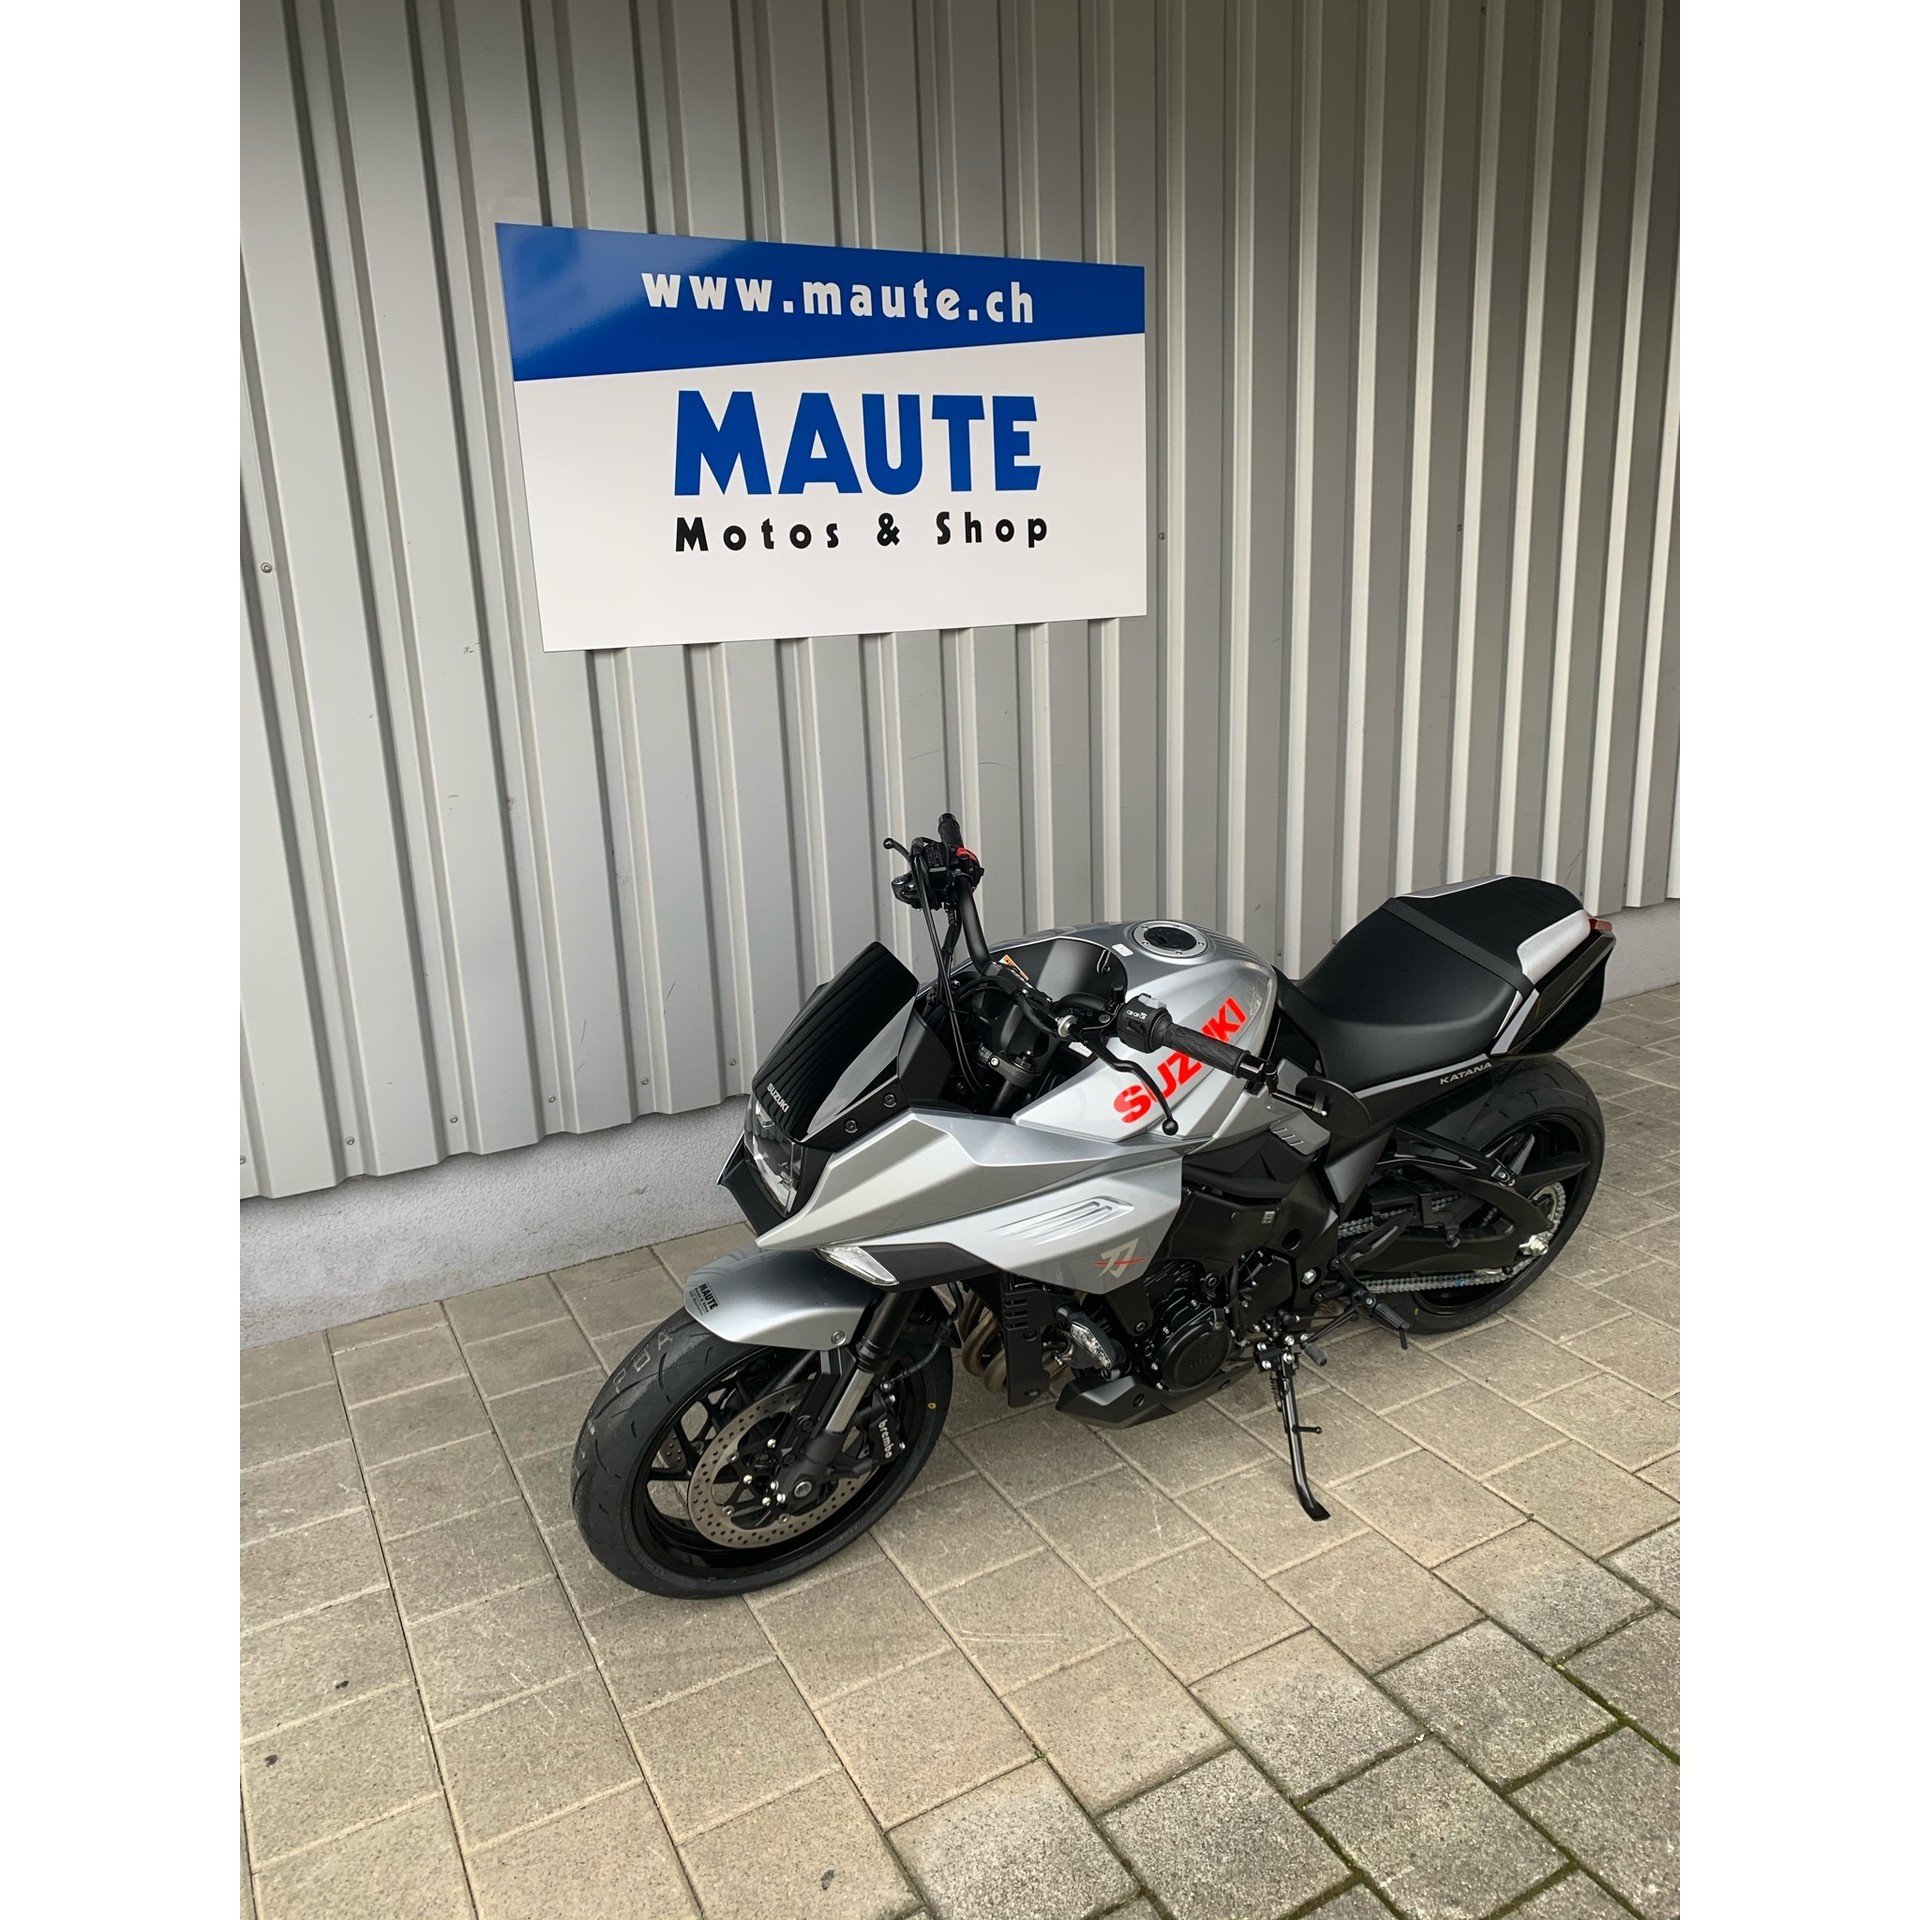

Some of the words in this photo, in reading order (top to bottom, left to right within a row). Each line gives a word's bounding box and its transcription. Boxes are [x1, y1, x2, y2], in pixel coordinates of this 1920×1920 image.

[641, 272, 1033, 323] www.maute.ch
[674, 389, 1041, 496] MAUTE
[675, 516, 839, 552] Motos
[876, 512, 900, 547] &
[936, 511, 1047, 549] Shop
[1440, 1062, 1492, 1085] KATANA
[766, 1083, 790, 1113] SUZUKI
[698, 1283, 718, 1310] MAUTE
[878, 1418, 894, 1459] brembo
